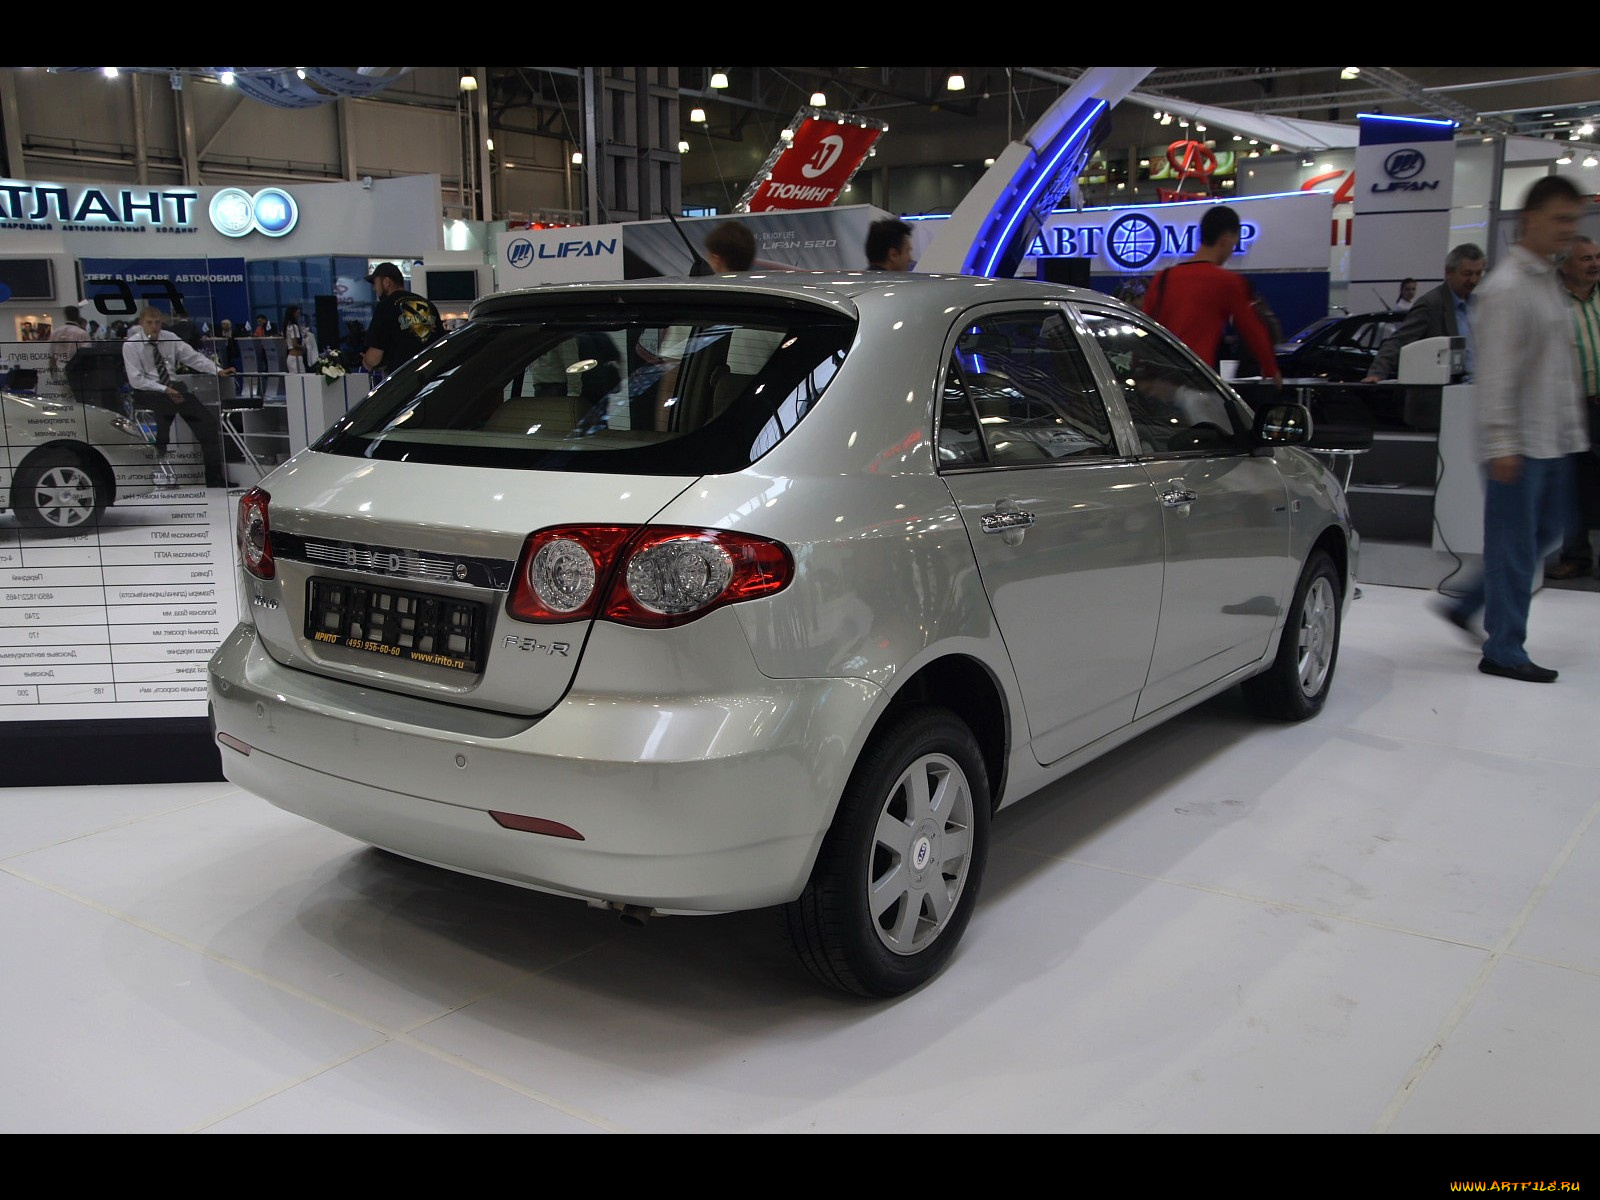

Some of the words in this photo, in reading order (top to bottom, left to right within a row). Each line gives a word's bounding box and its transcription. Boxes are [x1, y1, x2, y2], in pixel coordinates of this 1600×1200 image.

[766, 182, 834, 202] ТЮНИНГ
[1371, 180, 1440, 194] LIFAN
[62, 224, 146, 233] АВТОМОБИЛЬНЫЙ
[155, 226, 199, 234] ХОЛДИНГ
[538, 238, 617, 258] LIFAN
[762, 241, 801, 250] LIFAN
[804, 239, 837, 249] 520
[175, 274, 244, 284] АВТОМОБИЛЯ
[346, 548, 400, 573] BYD
[314, 630, 338, 644] ИРИТО
[345, 637, 364, 649] (495)
[364, 639, 401, 656] 956-60-60
[411, 650, 464, 669] www.irito.ru
[501, 634, 571, 658] F3-R
